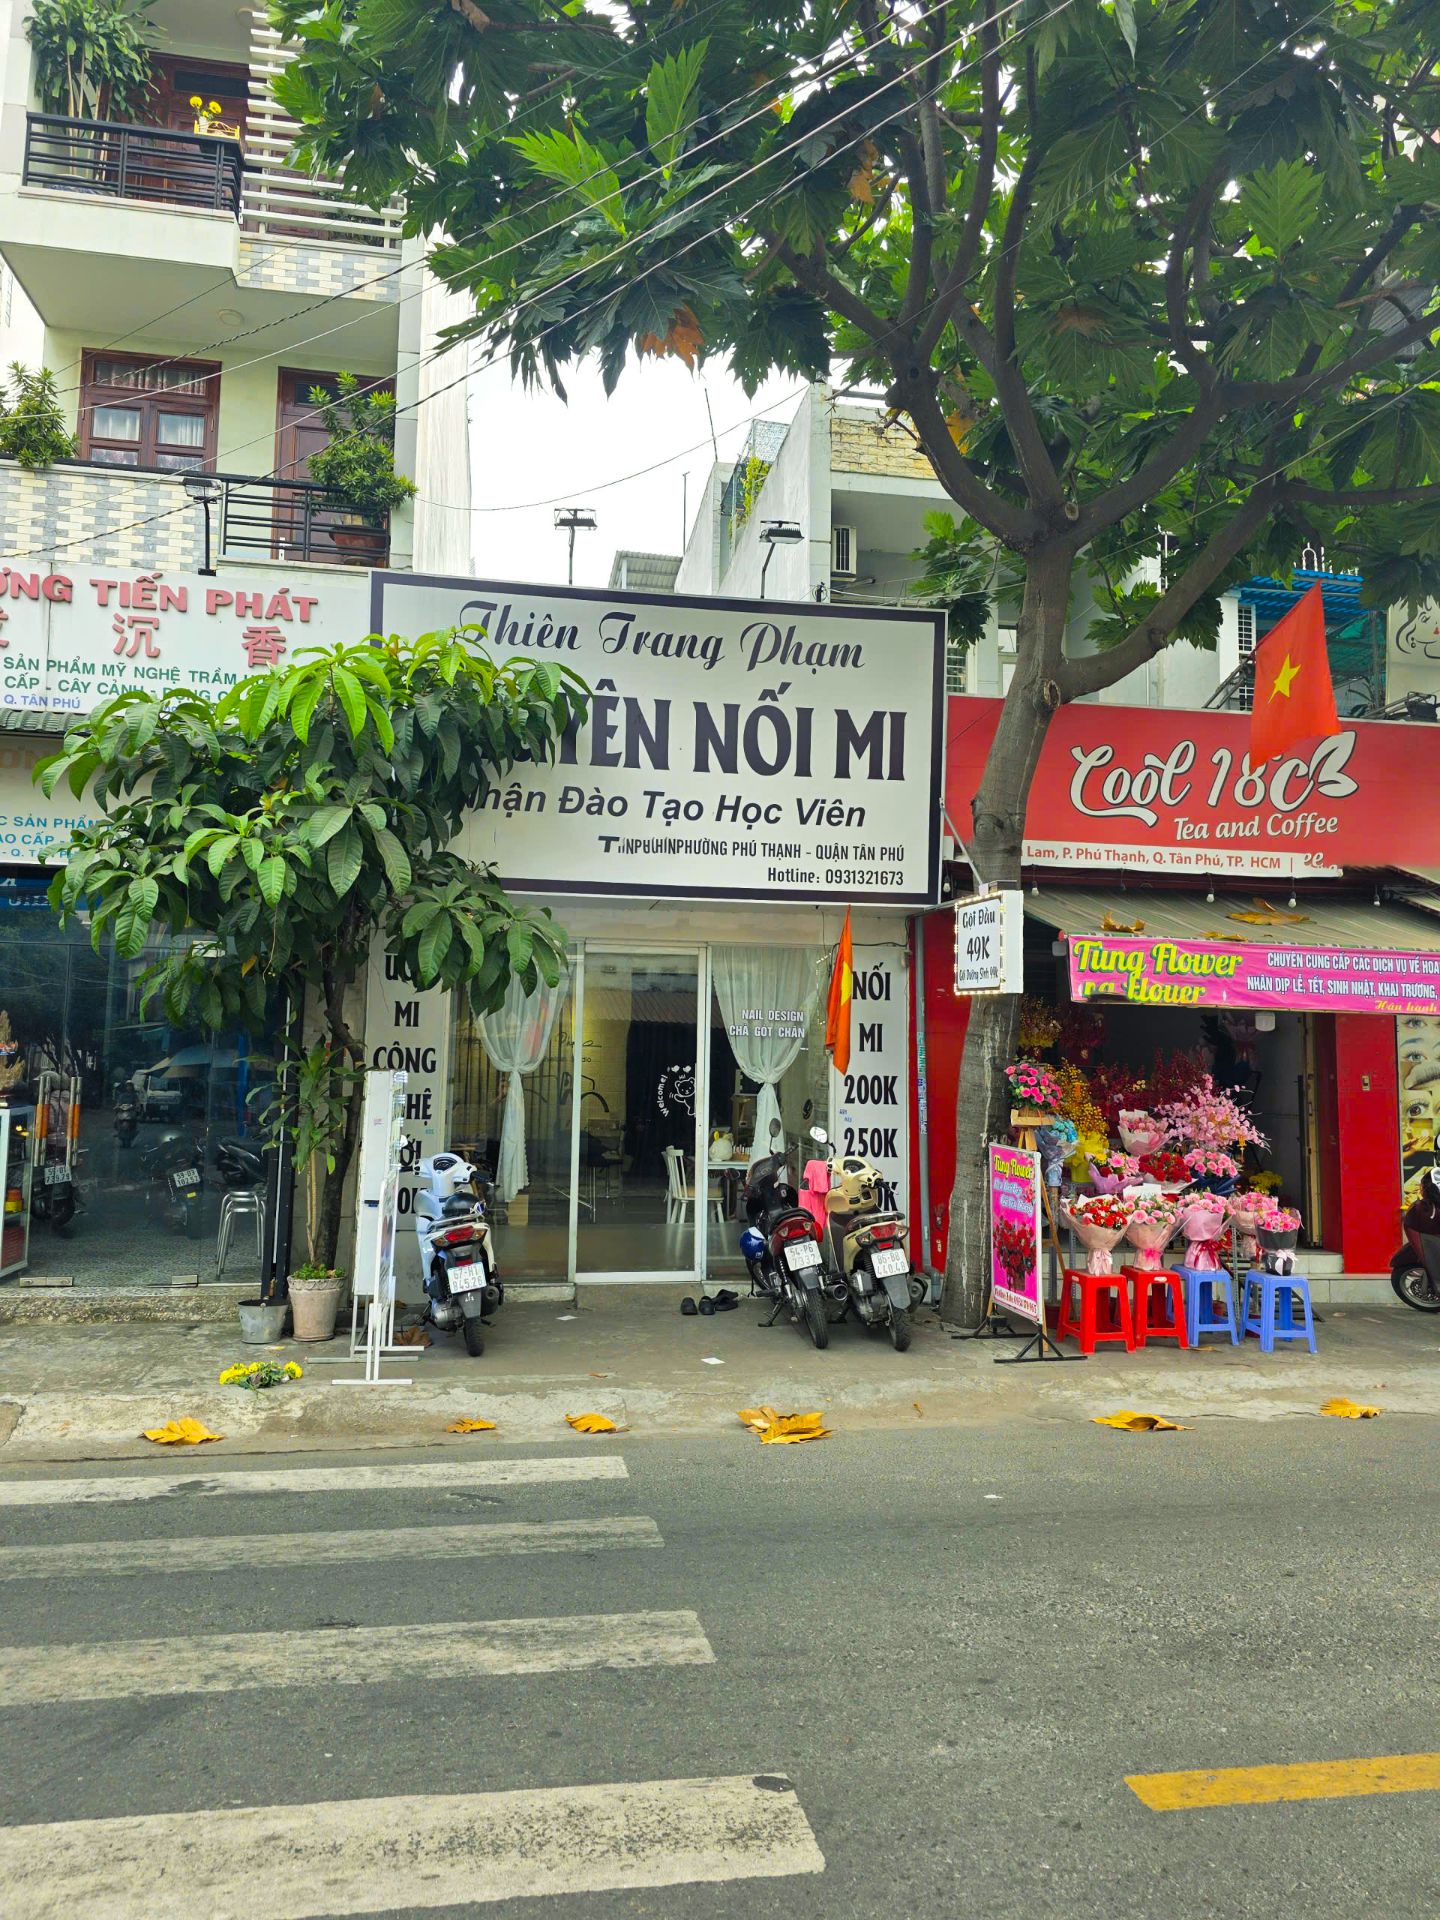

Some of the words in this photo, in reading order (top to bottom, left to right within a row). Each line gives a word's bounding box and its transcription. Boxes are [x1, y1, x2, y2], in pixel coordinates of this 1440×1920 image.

[90, 573, 187, 613] TIẾN
[206, 588, 318, 622] PHÁT
[242, 626, 286, 667] 香
[460, 600, 582, 650] Thiên
[599, 611, 725, 670] Trang
[740, 622, 865, 675] Phạm
[3, 653, 39, 671] SẢN
[46, 655, 96, 675] PHẨM
[102, 662, 126, 677] MỸ
[134, 666, 180, 684] NGHỆ
[4, 671, 39, 689] CẤP
[58, 678, 91, 694] CÂY
[693, 682, 814, 777] NỐI
[834, 709, 907, 781] MI
[1070, 740, 1197, 827] Cool
[558, 786, 628, 817] Đào
[643, 790, 704, 826] Tạo
[715, 795, 783, 830] Học
[796, 797, 866, 828] Viên
[1174, 817, 1209, 840] Tea
[1215, 815, 1261, 838] and
[1266, 812, 1338, 839] Coffee
[732, 840, 757, 857] PHÚ
[761, 843, 801, 861] THẠNH
[816, 843, 848, 862] QUẬN
[853, 843, 875, 861] TÂN
[880, 845, 904, 862] PHÚ
[1076, 848, 1101, 860] Phú
[1169, 852, 1192, 864] Tân
[1226, 855, 1244, 868] TP.
[1250, 856, 1281, 869] HCM
[768, 867, 820, 884] Hotline:
[825, 869, 904, 886] 0931321673
[967, 935, 990, 962] 49K
[1151, 943, 1243, 977] Flower
[1268, 951, 1303, 968] CHUYÊN
[1305, 954, 1330, 969] CUNG
[1332, 952, 1350, 970] CẤP
[1373, 958, 1394, 974] DỊCH
[852, 962, 891, 1001] NỐI
[1247, 974, 1273, 991] NHÂN
[1327, 980, 1349, 994] SINH
[1378, 982, 1399, 996] KHAI
[394, 1001, 420, 1027] MI
[742, 1009, 763, 1020] NAIL
[768, 1010, 804, 1022] DESIGN
[859, 1023, 883, 1052] MI
[373, 1041, 437, 1073] CÔNG
[844, 1075, 898, 1105] 200K
[844, 1127, 898, 1158] 250K
